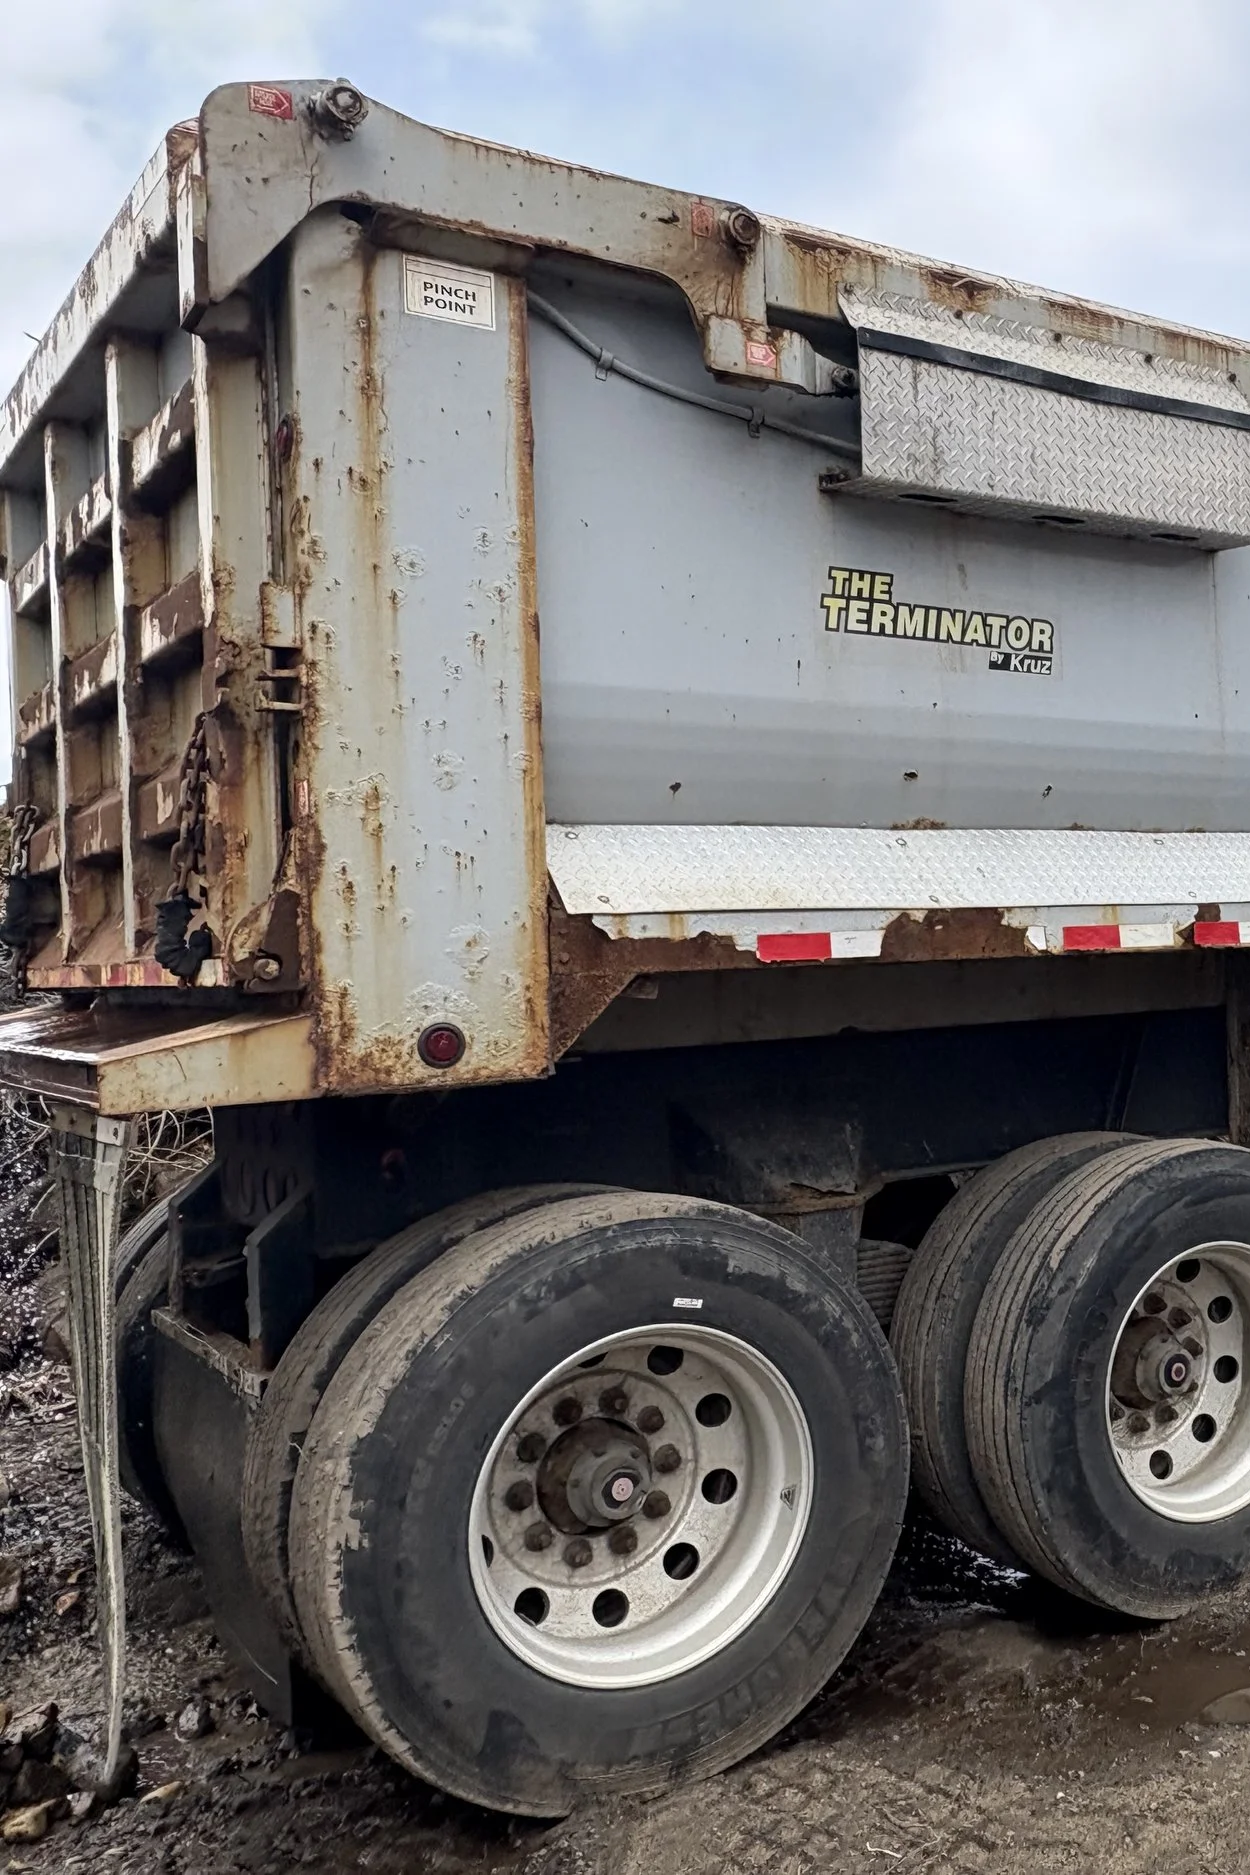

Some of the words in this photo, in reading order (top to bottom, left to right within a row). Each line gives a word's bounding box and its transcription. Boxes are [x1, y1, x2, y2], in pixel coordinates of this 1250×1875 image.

[423, 281, 477, 302] PINCH
[423, 295, 477, 316] POINT
[829, 567, 893, 600] THE
[821, 595, 1054, 653] TERMINATOR
[1009, 653, 1051, 675] Kruz
